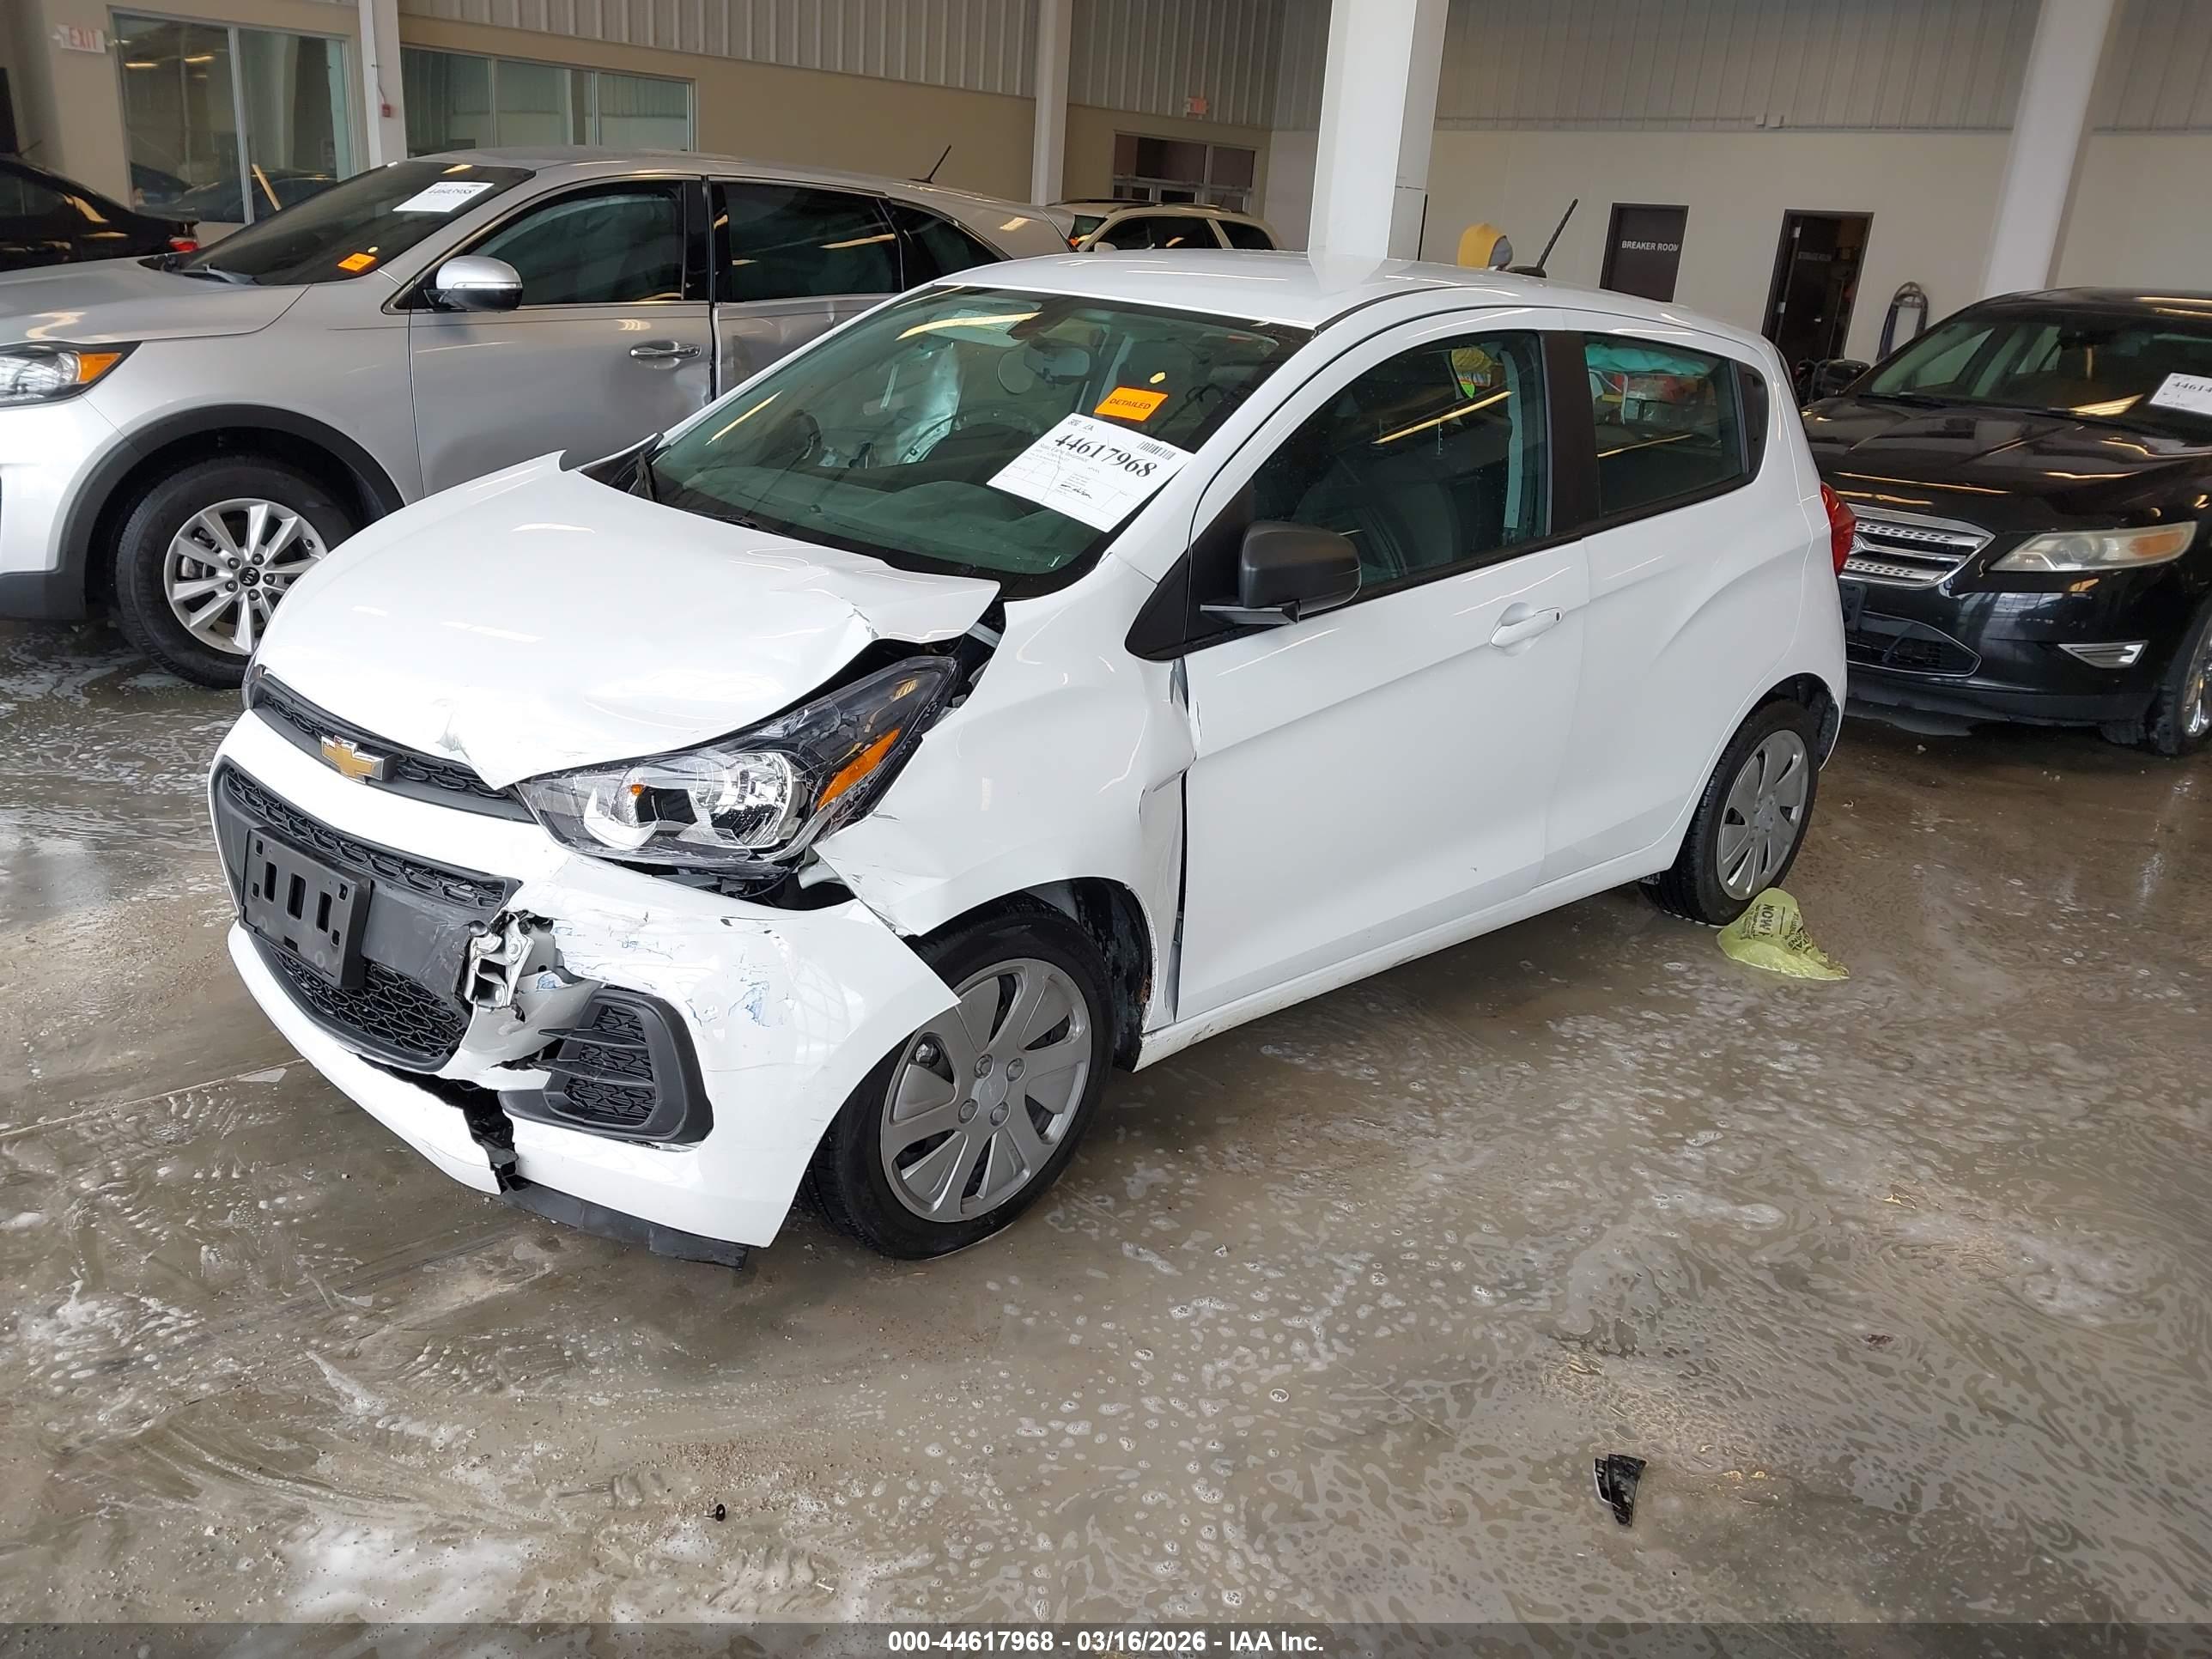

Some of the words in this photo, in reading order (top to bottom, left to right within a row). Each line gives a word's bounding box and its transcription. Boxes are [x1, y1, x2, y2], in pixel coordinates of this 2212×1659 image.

[68, 27, 97, 50] EXIT
[1621, 240, 1656, 251] BREAKER
[1109, 398, 1152, 410] DETAILED
[1054, 433, 1158, 478] 44617968
